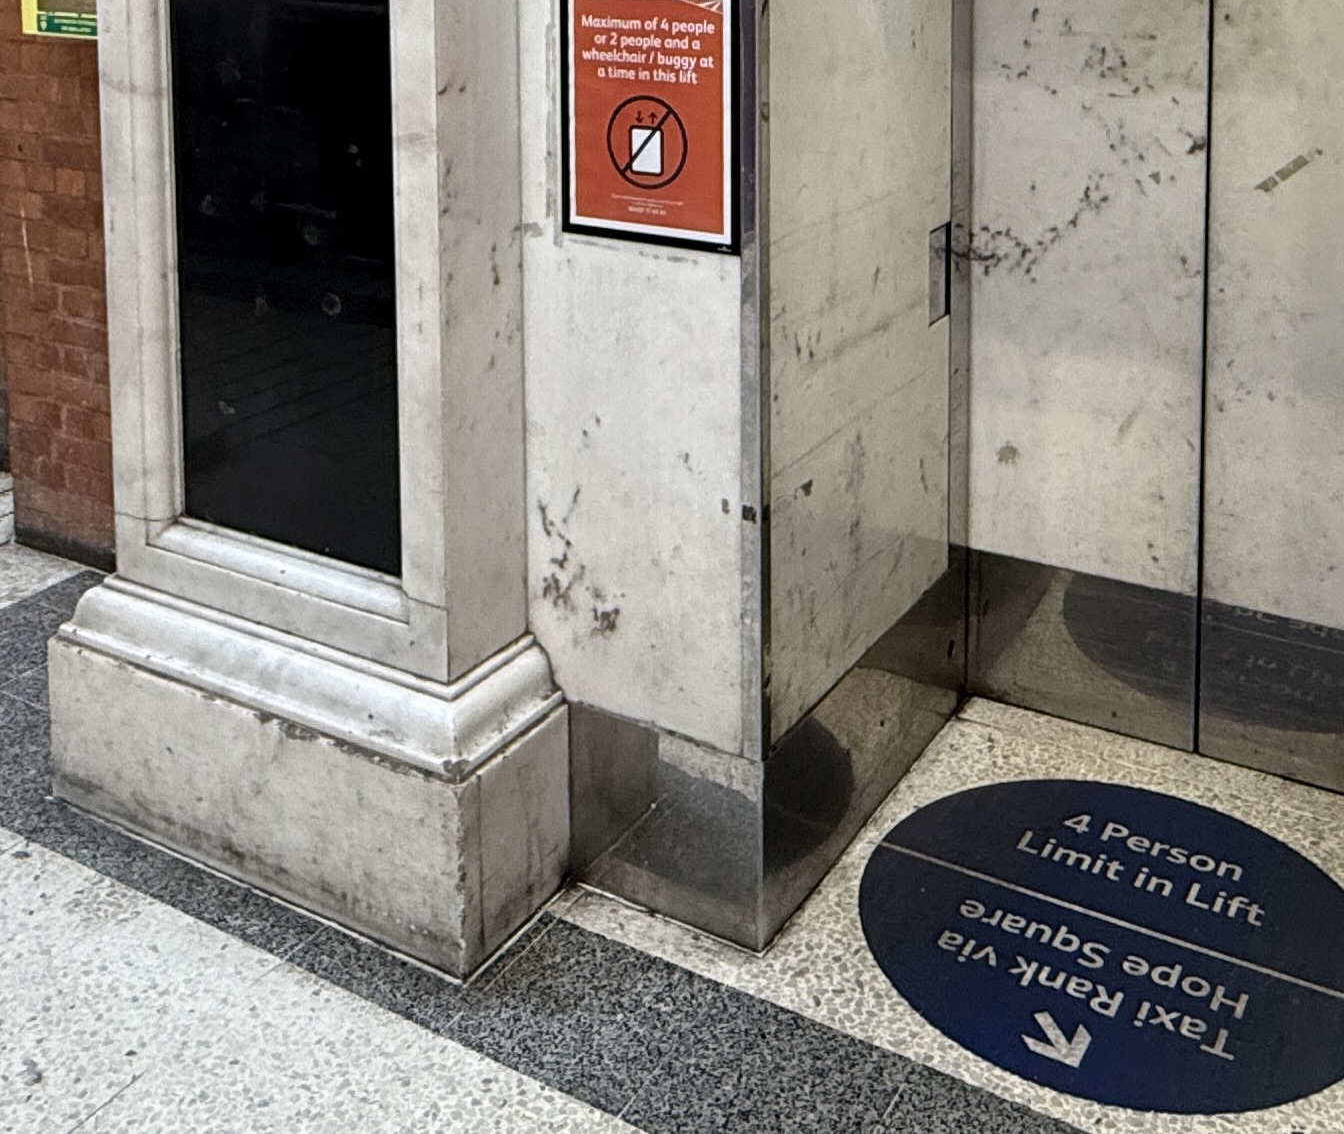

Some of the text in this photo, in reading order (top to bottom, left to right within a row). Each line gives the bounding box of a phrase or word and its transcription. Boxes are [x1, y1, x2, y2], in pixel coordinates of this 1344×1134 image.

[581, 15, 715, 36] Maximum of 4 people
[594, 32, 701, 50] or 2 people and a
[582, 49, 714, 70] wheelchair / buggy at
[597, 66, 698, 84] a time in this lift
[1063, 814, 1244, 882] 4 Person
[1016, 830, 1266, 928] Limit in Lift
[959, 898, 1250, 1020] Hope Square
[937, 929, 1235, 1061] Taxi Rank via
